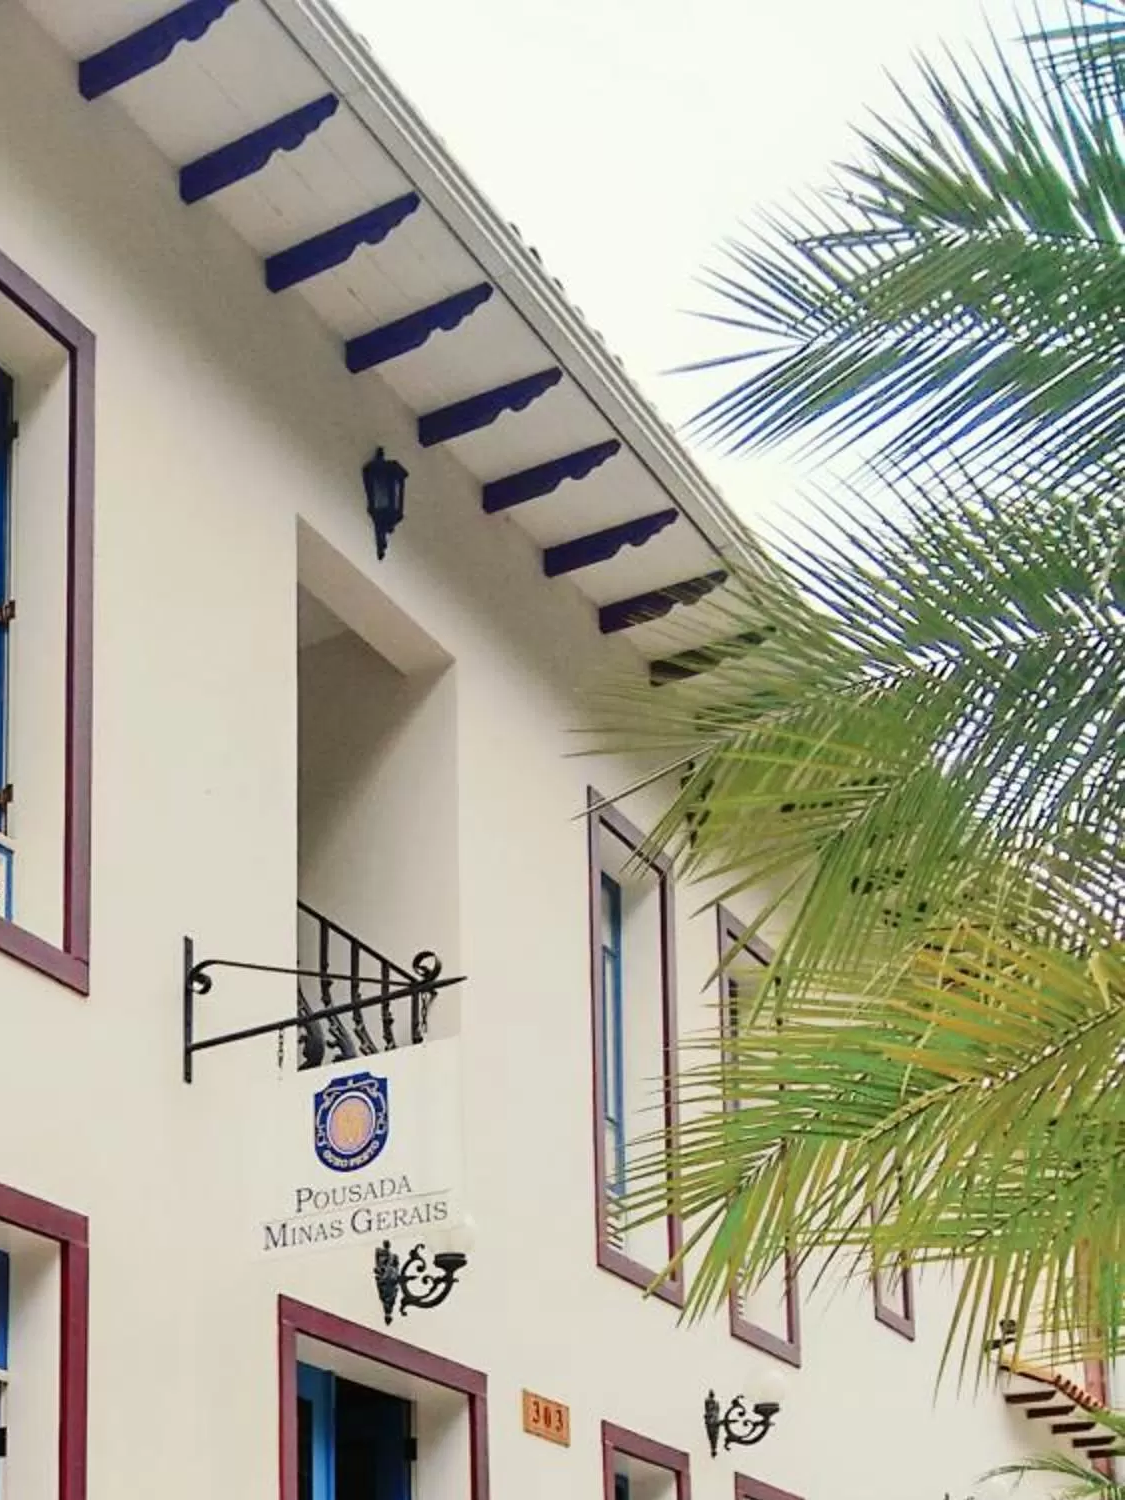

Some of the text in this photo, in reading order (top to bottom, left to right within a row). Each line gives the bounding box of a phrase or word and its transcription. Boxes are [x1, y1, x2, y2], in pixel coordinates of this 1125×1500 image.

[295, 1175, 412, 1213] POUSADA
[263, 1201, 449, 1251] MINAS GERAIS
[532, 1400, 564, 1433] 303
